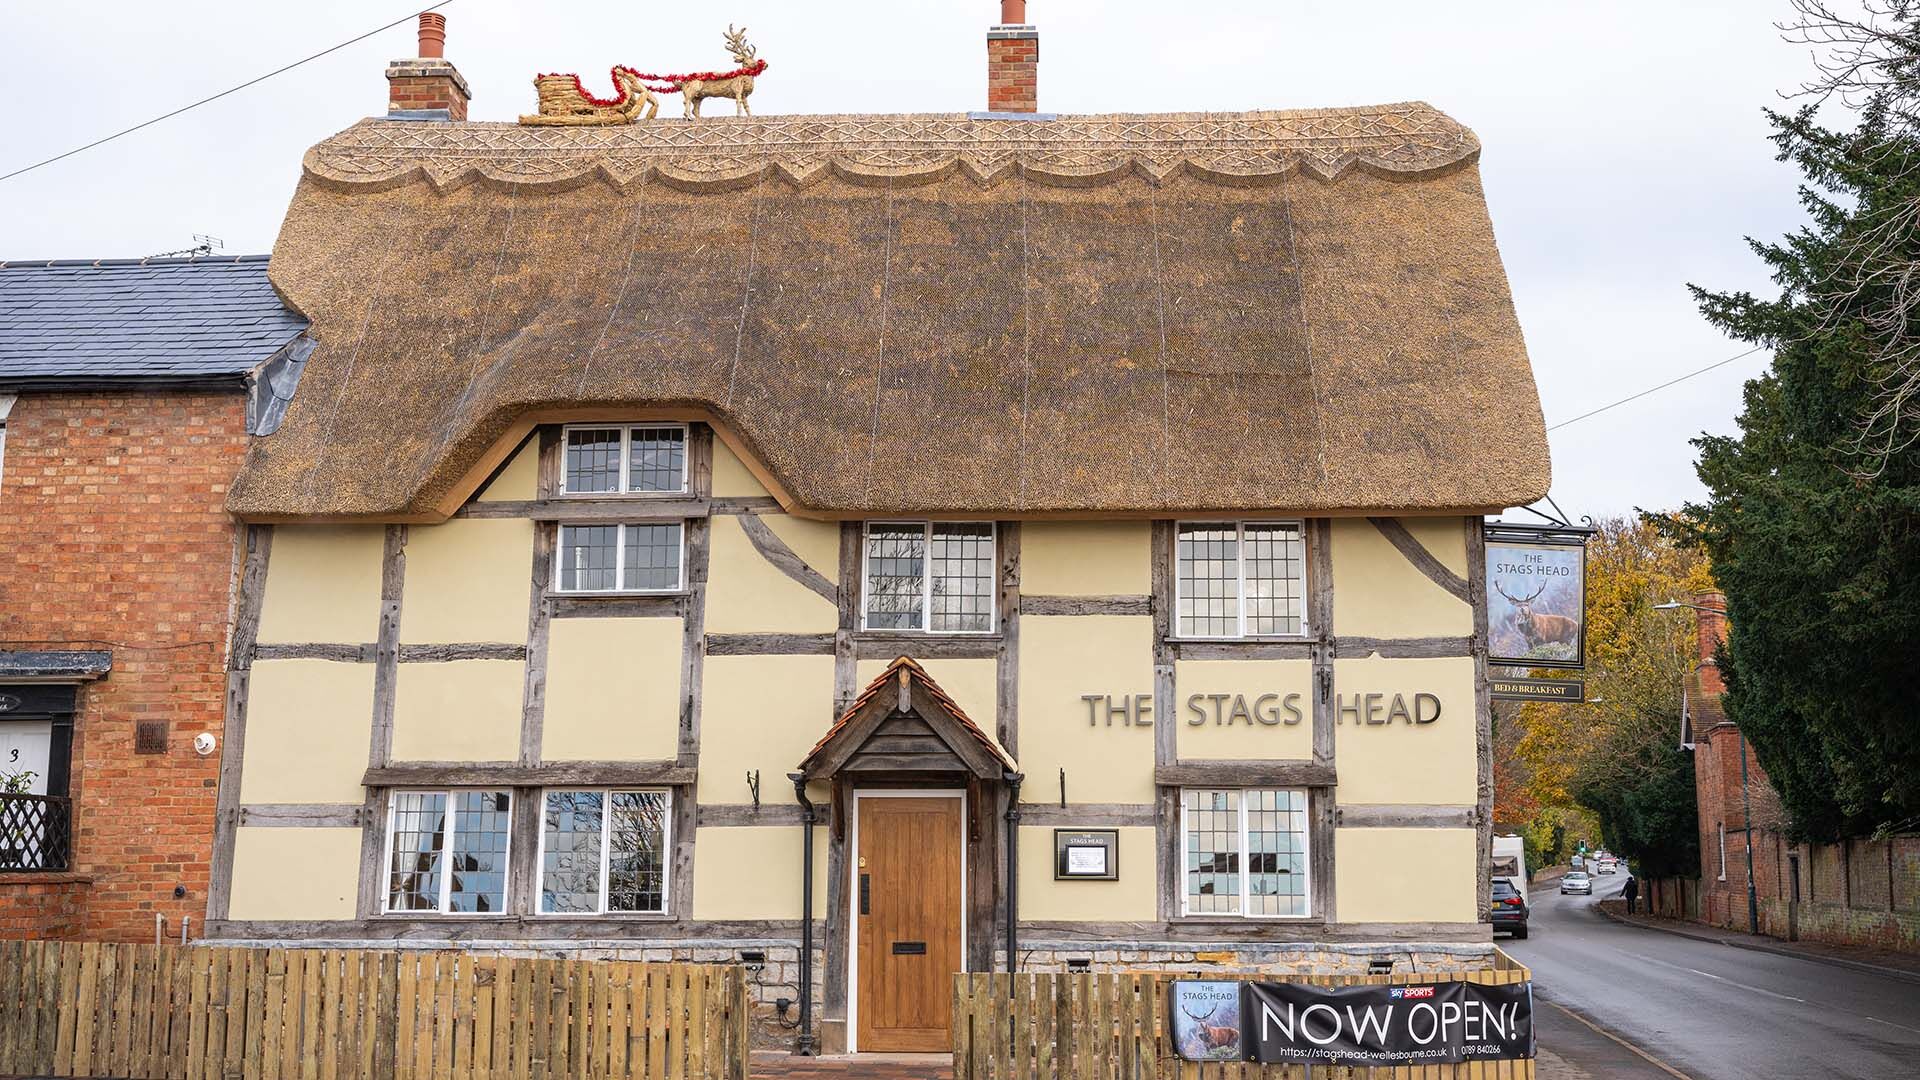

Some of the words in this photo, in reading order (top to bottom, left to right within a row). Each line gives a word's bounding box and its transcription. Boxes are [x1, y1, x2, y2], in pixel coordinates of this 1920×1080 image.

[1524, 554, 1543, 564] THE
[1497, 563, 1533, 575] STAGS
[1536, 566, 1570, 577] HEAD
[1494, 683, 1511, 692] BED
[1519, 685, 1566, 695] BREAKFAST
[1081, 694, 1153, 727] THE
[1187, 693, 1303, 727] STAGS
[1336, 693, 1442, 725] HEAD
[9, 748, 19, 763] 3
[1183, 992, 1208, 1000] STAGS
[1210, 992, 1233, 1000] HEAD
[1404, 987, 1433, 997] SPORTS
[1261, 1001, 1394, 1046] NOW
[1407, 1001, 1519, 1045] OPEN!
[1477, 1044, 1501, 1054] 840266
